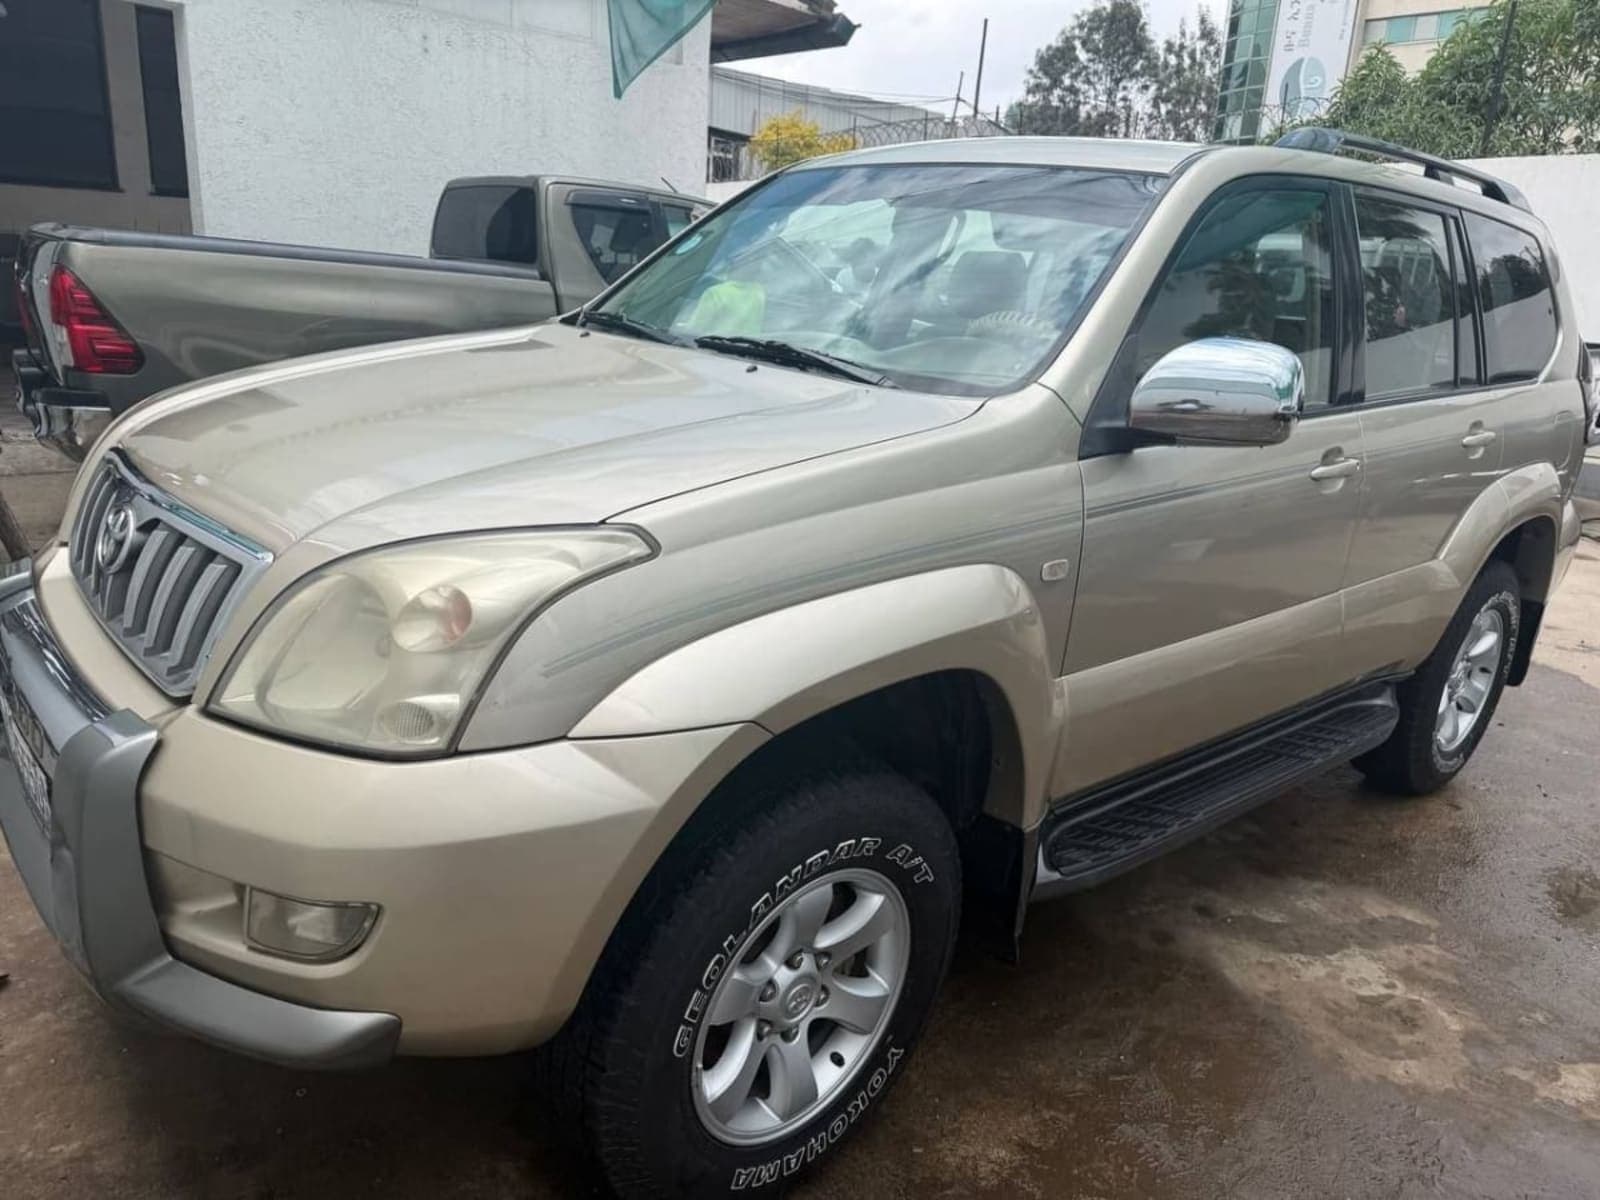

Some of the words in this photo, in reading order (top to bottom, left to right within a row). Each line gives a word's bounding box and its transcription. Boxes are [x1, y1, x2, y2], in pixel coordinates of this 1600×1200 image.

[673, 837, 882, 1057] GEOLANDAR
[886, 843, 935, 884] A/T
[730, 1047, 904, 1190] YOKOHAMA
